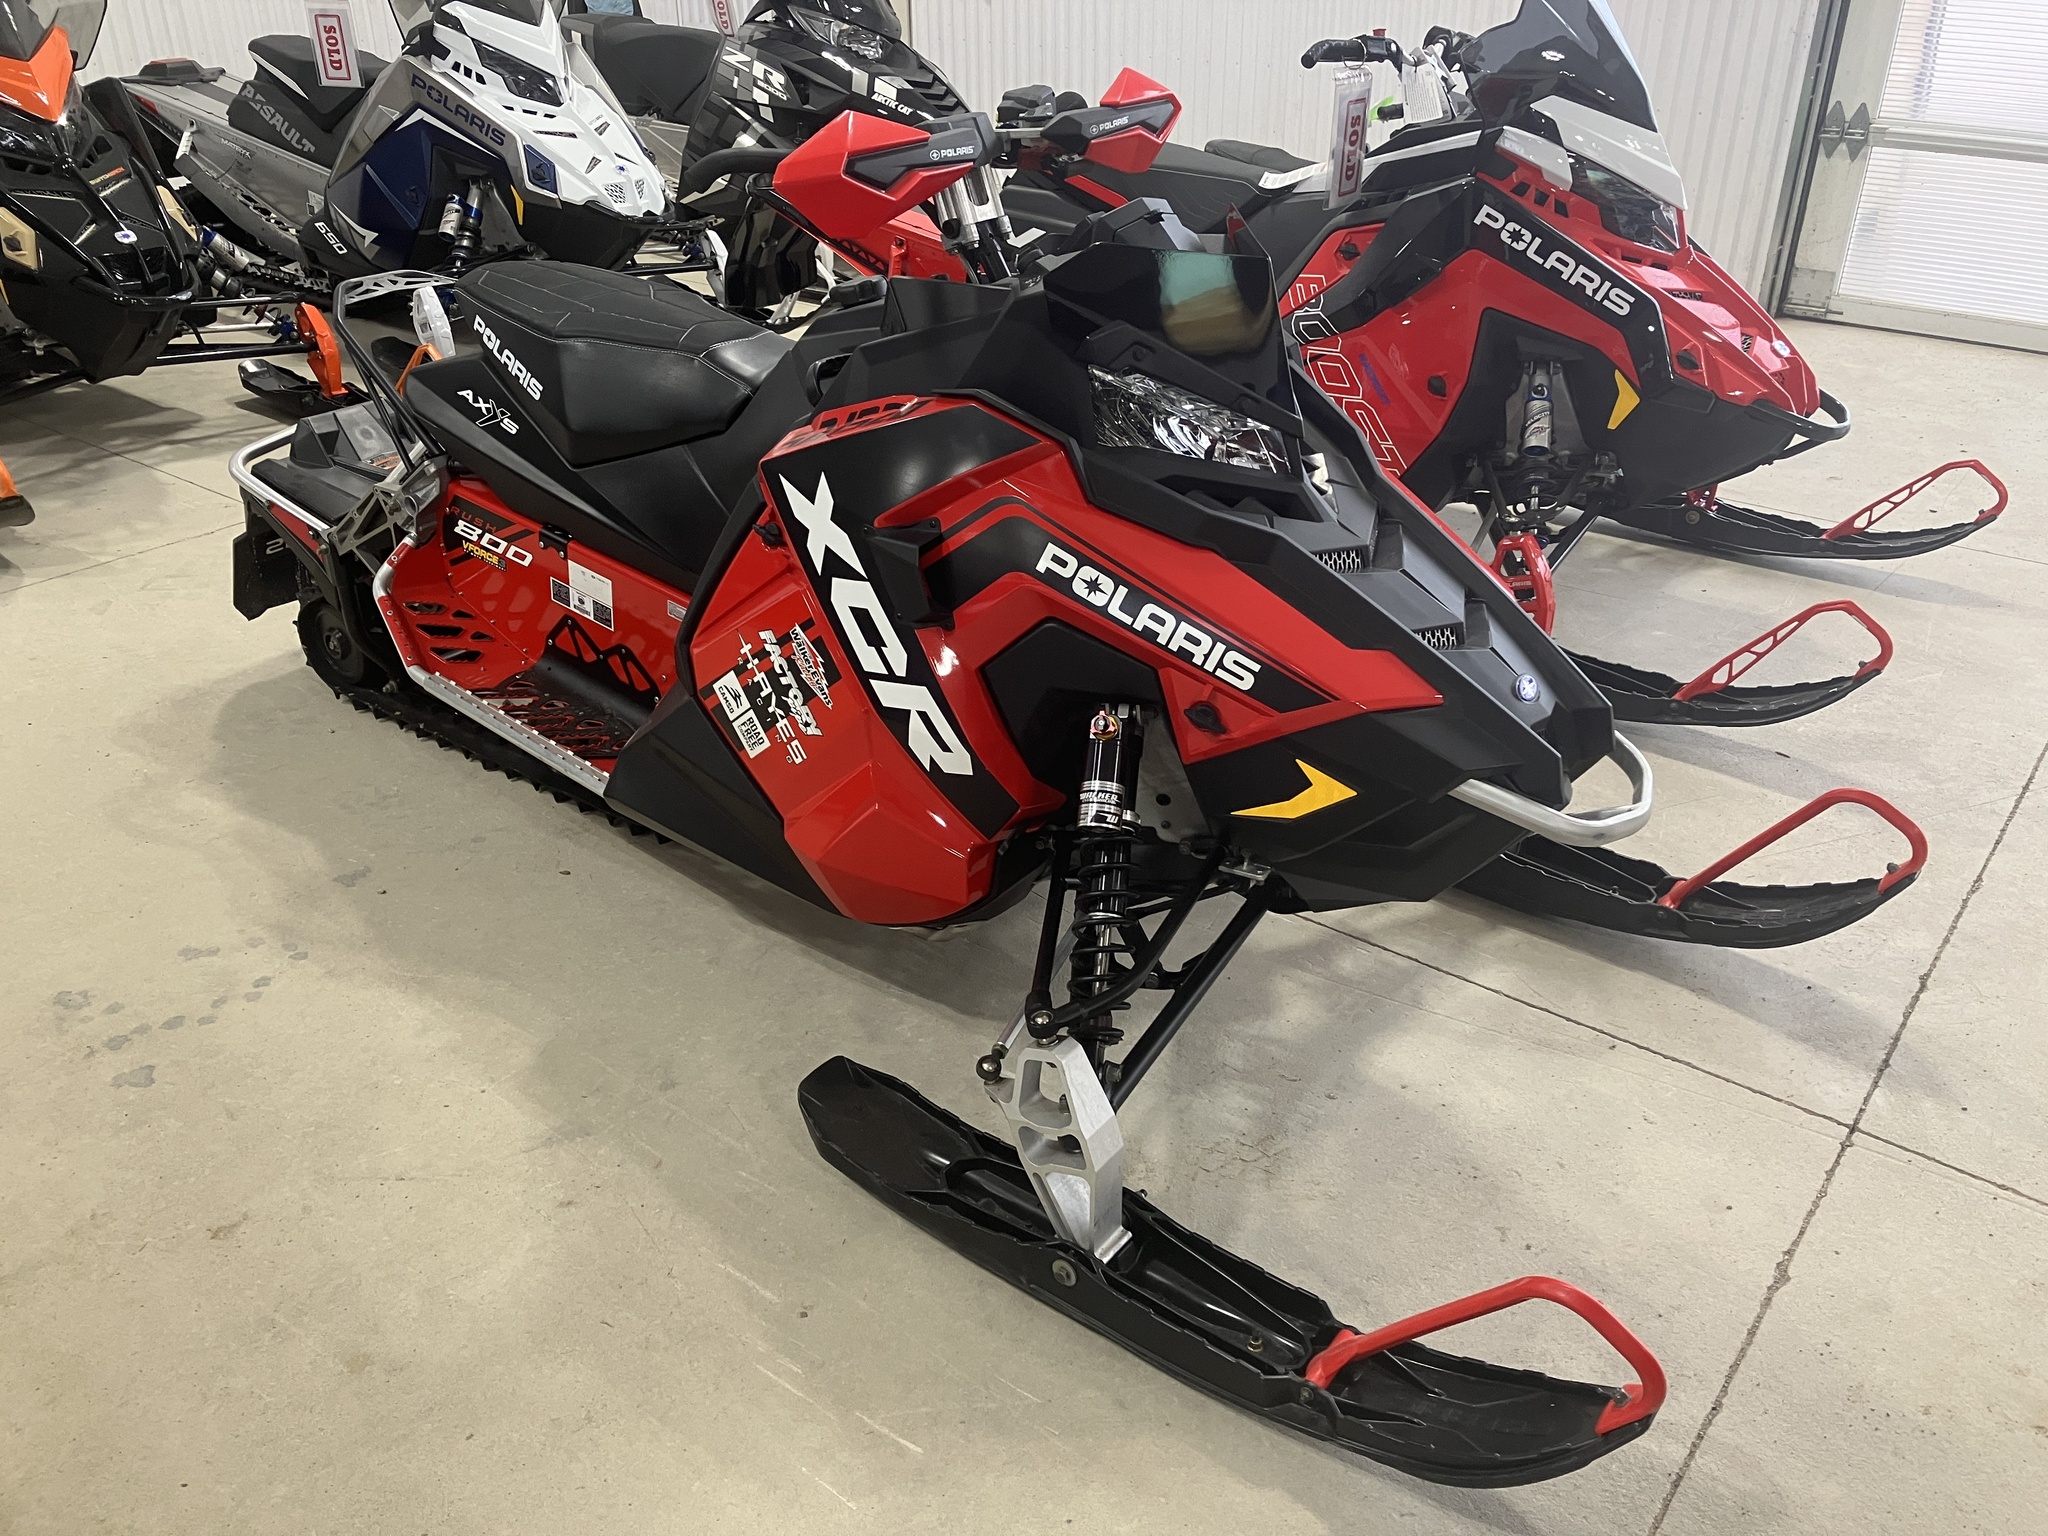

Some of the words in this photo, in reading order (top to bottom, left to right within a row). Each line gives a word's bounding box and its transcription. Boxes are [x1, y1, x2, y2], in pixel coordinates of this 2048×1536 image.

[717, 0, 729, 30] OLD
[323, 25, 343, 71] SOLD
[721, 46, 786, 93] ZR
[240, 83, 316, 153] ASSAULT
[411, 73, 506, 147] POLARIS
[870, 92, 899, 109] ARCTIC
[897, 103, 914, 116] CAT
[1099, 116, 1129, 131] POLARIS
[940, 145, 975, 159] POLARIS
[1345, 114, 1362, 182] SOLD
[314, 221, 348, 255] 650
[1473, 204, 1636, 316] POLARIS
[473, 314, 544, 401] POLARIS
[457, 389, 520, 435] AXYS
[450, 506, 497, 533] RUSH
[453, 519, 534, 567] 800
[778, 471, 973, 776] XCR
[1035, 541, 1262, 691] POLARIS
[758, 629, 823, 736] FACTORY
[790, 627, 814, 673] Walker
[811, 669, 832, 706] Evans
[718, 686, 735, 714] CAMSO
[737, 657, 793, 764] RACING
[738, 634, 808, 765] HAYES
[740, 721, 760, 750] FREE
[746, 716, 765, 746] ROAD
